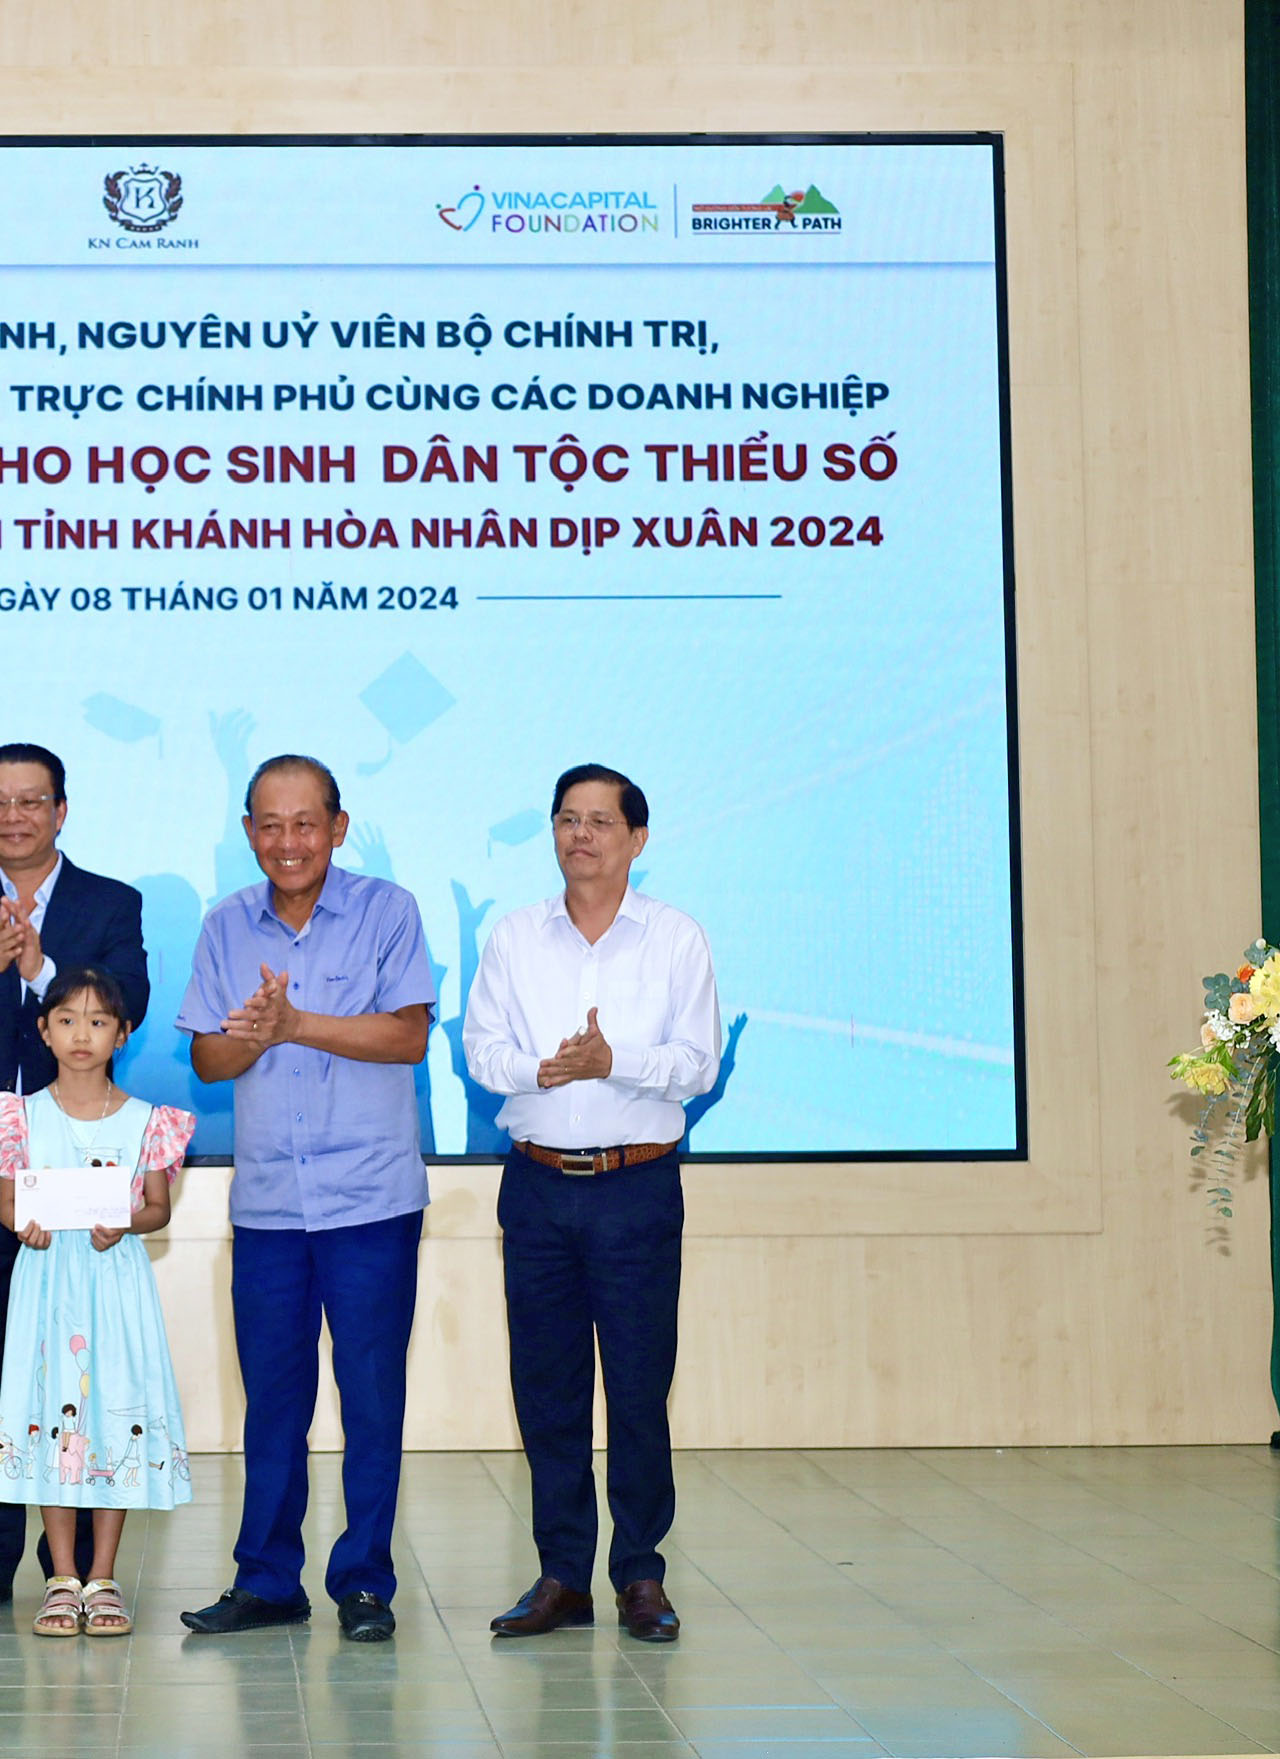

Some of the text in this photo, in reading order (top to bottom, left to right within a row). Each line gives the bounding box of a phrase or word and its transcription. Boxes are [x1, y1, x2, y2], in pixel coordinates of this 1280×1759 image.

[492, 191, 657, 209] VINACAPITAL
[492, 214, 658, 233] FOUNDATION
[692, 217, 842, 230] BRIGHTER PATH
[88, 237, 111, 249] KN
[78, 313, 251, 349] NGUYÊN
[263, 311, 319, 348] UỶ
[331, 313, 425, 348] VIÊN
[437, 313, 492, 356] BỘ
[504, 312, 632, 348] CHÍNH
[643, 320, 718, 355] TRỊ,
[10, 385, 123, 419] TRỰC
[137, 376, 262, 411] CHÍNH
[274, 375, 354, 411] PHỦ
[366, 376, 480, 411] CÙNG
[491, 375, 576, 410] CÁC
[588, 383, 732, 410] DOANH
[742, 374, 889, 417] NGHIỆP
[88, 446, 211, 494] HỌC
[227, 445, 355, 484] SINH
[383, 434, 498, 483] DÂN
[513, 434, 629, 493] TỘC
[644, 431, 807, 482] THIỂU
[823, 431, 898, 481] SỐ
[14, 508, 117, 549] TỈNH
[133, 509, 290, 549] KHÁNH
[303, 509, 399, 549] HÒA
[412, 508, 537, 548] NHÂN
[550, 517, 620, 556] DỊP
[633, 507, 758, 547] XUÂN
[770, 516, 884, 547] 2024
[71, 588, 111, 611] 08
[121, 581, 238, 610] THÁNG
[248, 587, 281, 610] 01
[294, 581, 367, 610] NĂM
[378, 586, 458, 610] 2024
